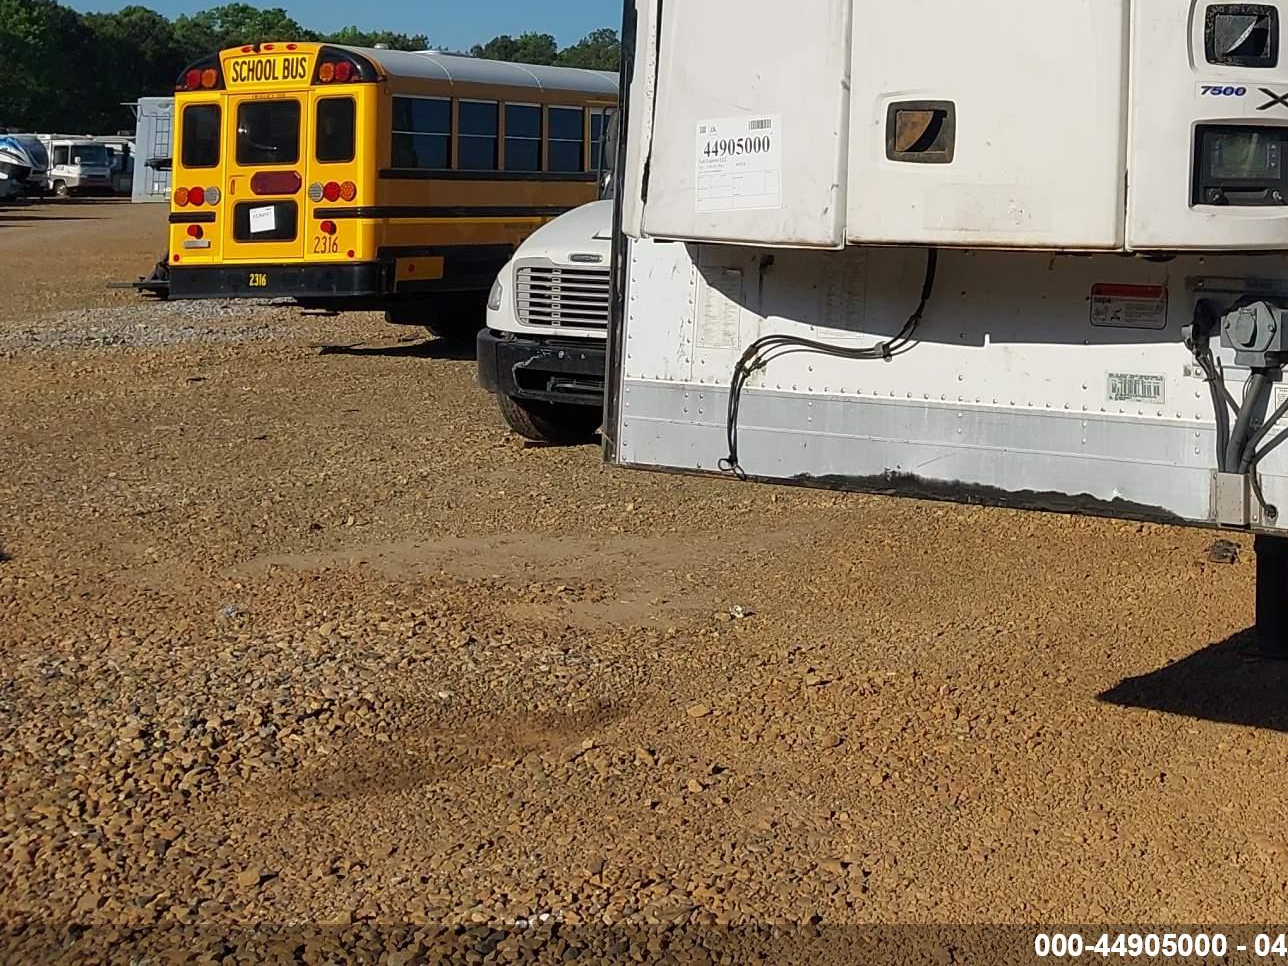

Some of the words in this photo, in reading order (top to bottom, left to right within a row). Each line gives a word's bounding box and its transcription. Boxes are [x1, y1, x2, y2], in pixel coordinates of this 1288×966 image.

[232, 58, 278, 82] SCHOOL
[282, 57, 307, 80] BUS
[1200, 85, 1247, 97] 7500
[703, 135, 771, 157] 44905000
[313, 236, 338, 254] 2316
[249, 273, 267, 287] 2316
